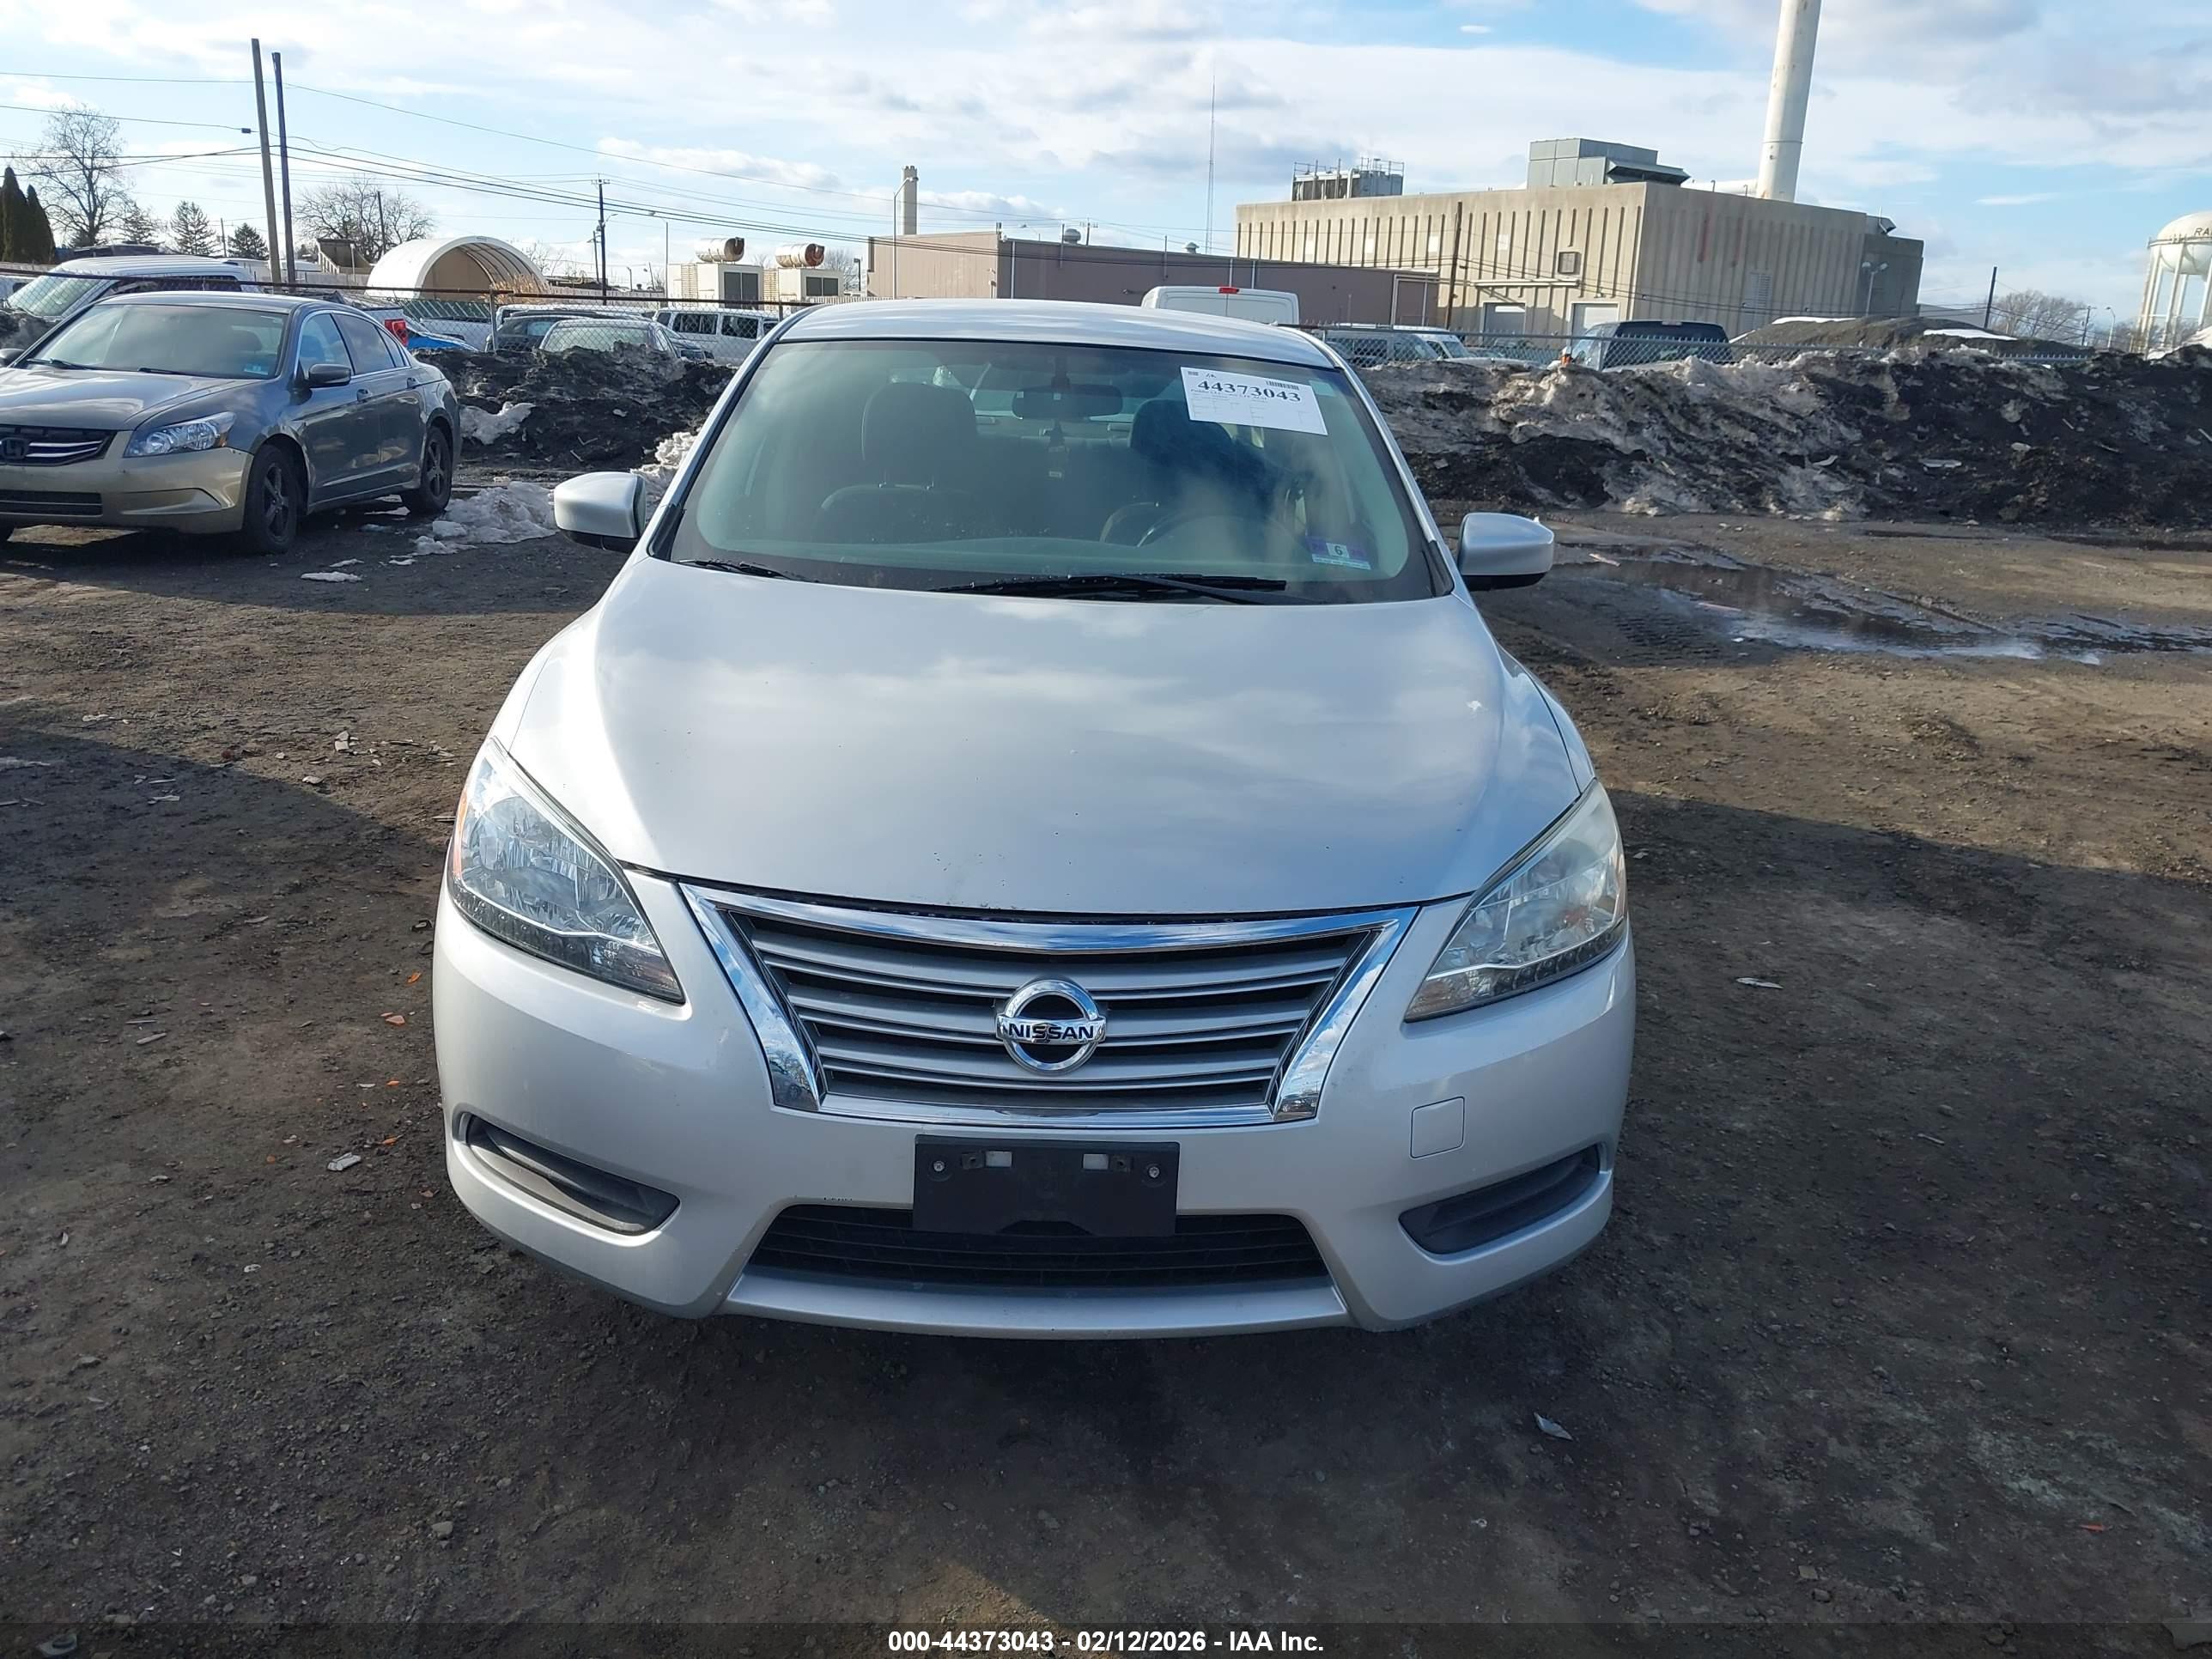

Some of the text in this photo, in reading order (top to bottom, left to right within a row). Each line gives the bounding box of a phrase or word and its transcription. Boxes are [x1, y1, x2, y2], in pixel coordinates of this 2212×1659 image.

[2193, 227, 2212, 236] RA
[1197, 380, 1301, 403] 44373043
[1334, 545, 1343, 556] 6
[1008, 1023, 1093, 1041] NISSAN
